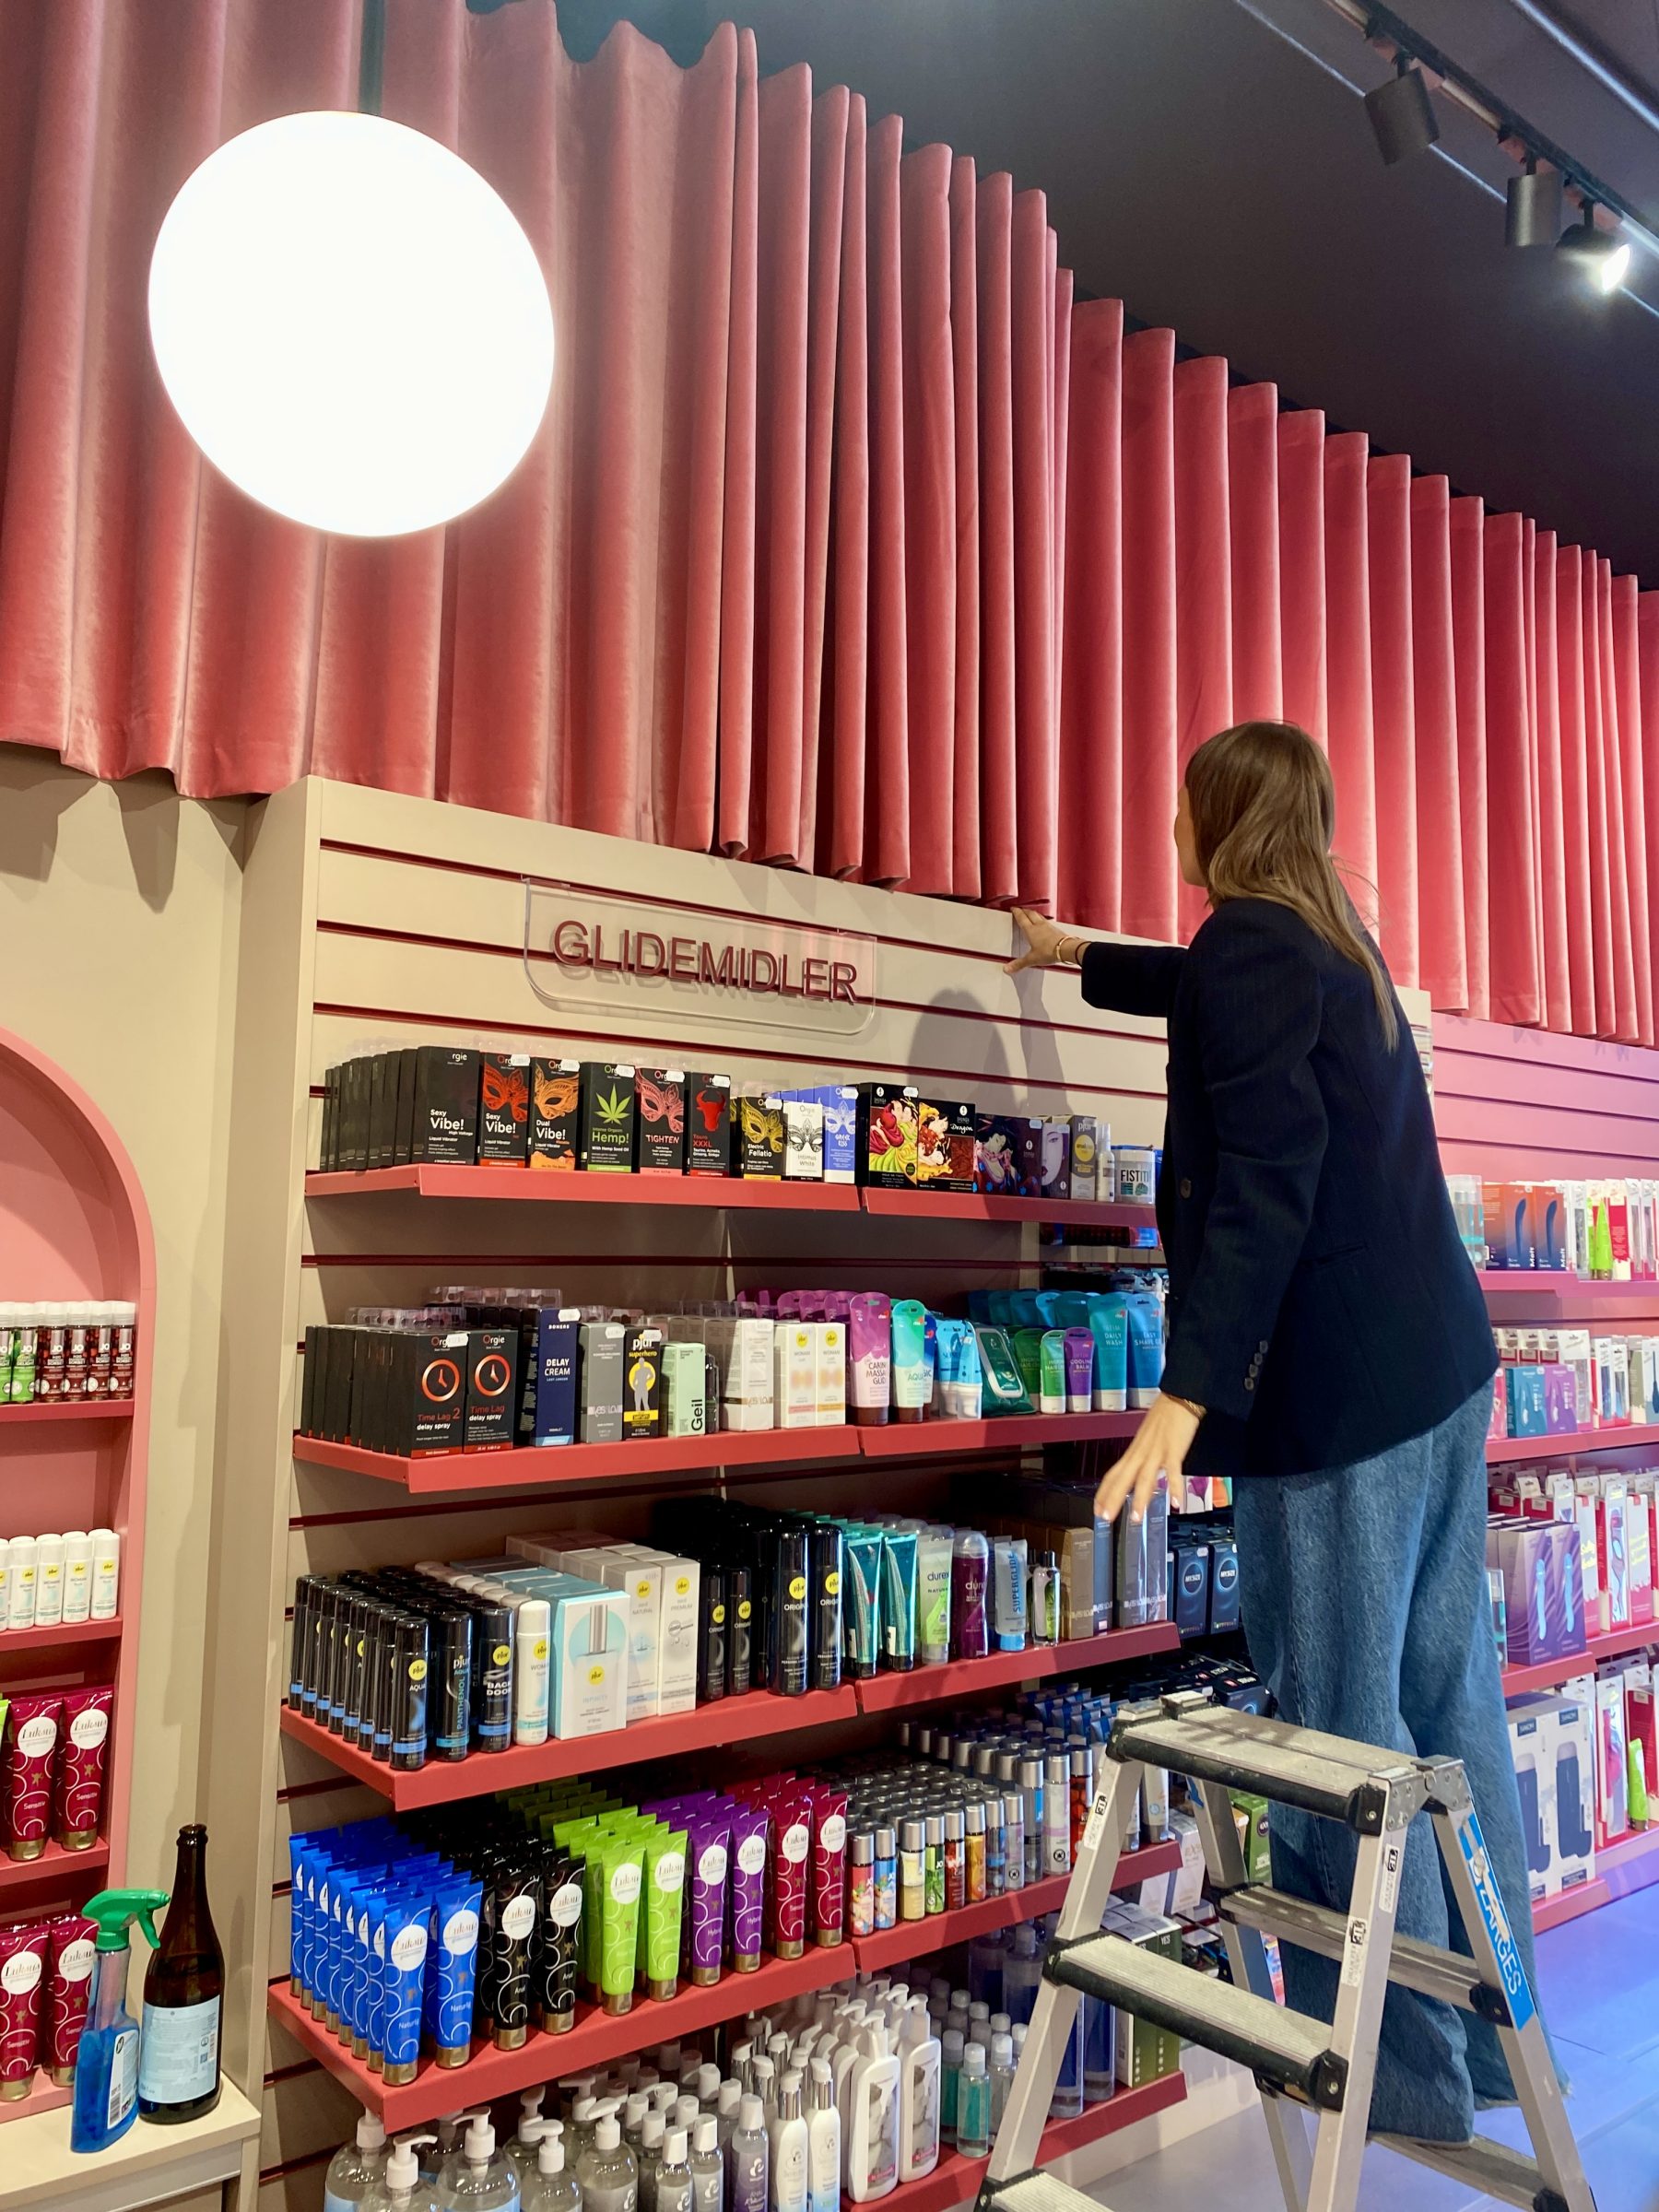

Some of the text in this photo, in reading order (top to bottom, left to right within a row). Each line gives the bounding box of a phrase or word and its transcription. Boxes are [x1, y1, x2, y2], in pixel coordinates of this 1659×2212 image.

[553, 920, 858, 1006] GLIDEMIDLER
[446, 1051, 468, 1063] rgie
[498, 1054, 512, 1066] Org
[548, 1060, 562, 1071] Org
[604, 1065, 618, 1077] Org
[654, 1070, 667, 1081] Org
[430, 1109, 447, 1118] Sexy
[486, 1112, 500, 1122] Sexy
[429, 1117, 465, 1131] Vibe!
[485, 1122, 516, 1134] Vibe!
[949, 1123, 974, 1134] Dragon
[535, 1127, 567, 1140] Vibe!
[592, 1132, 629, 1146] Hemp!
[646, 1135, 680, 1144] TIGHTEN
[748, 1149, 772, 1158] Fellatio
[431, 1335, 448, 1348] Org
[482, 1334, 505, 1347] Orgie
[547, 1358, 570, 1367] DELAY
[868, 1361, 887, 1370] CARIN
[545, 1367, 571, 1376] CREAM
[452, 1407, 461, 1419] 2
[471, 1405, 505, 1414] Time Lag
[691, 1398, 703, 1431] Geil
[486, 1413, 502, 1421] spray
[417, 1422, 451, 1431] delay spray
[1009, 1552, 1021, 1614] SUPERGLIDE
[453, 1654, 468, 1669] pju
[457, 1676, 465, 1730] PANTHENOL
[23, 1800, 46, 1811] Sensitiv
